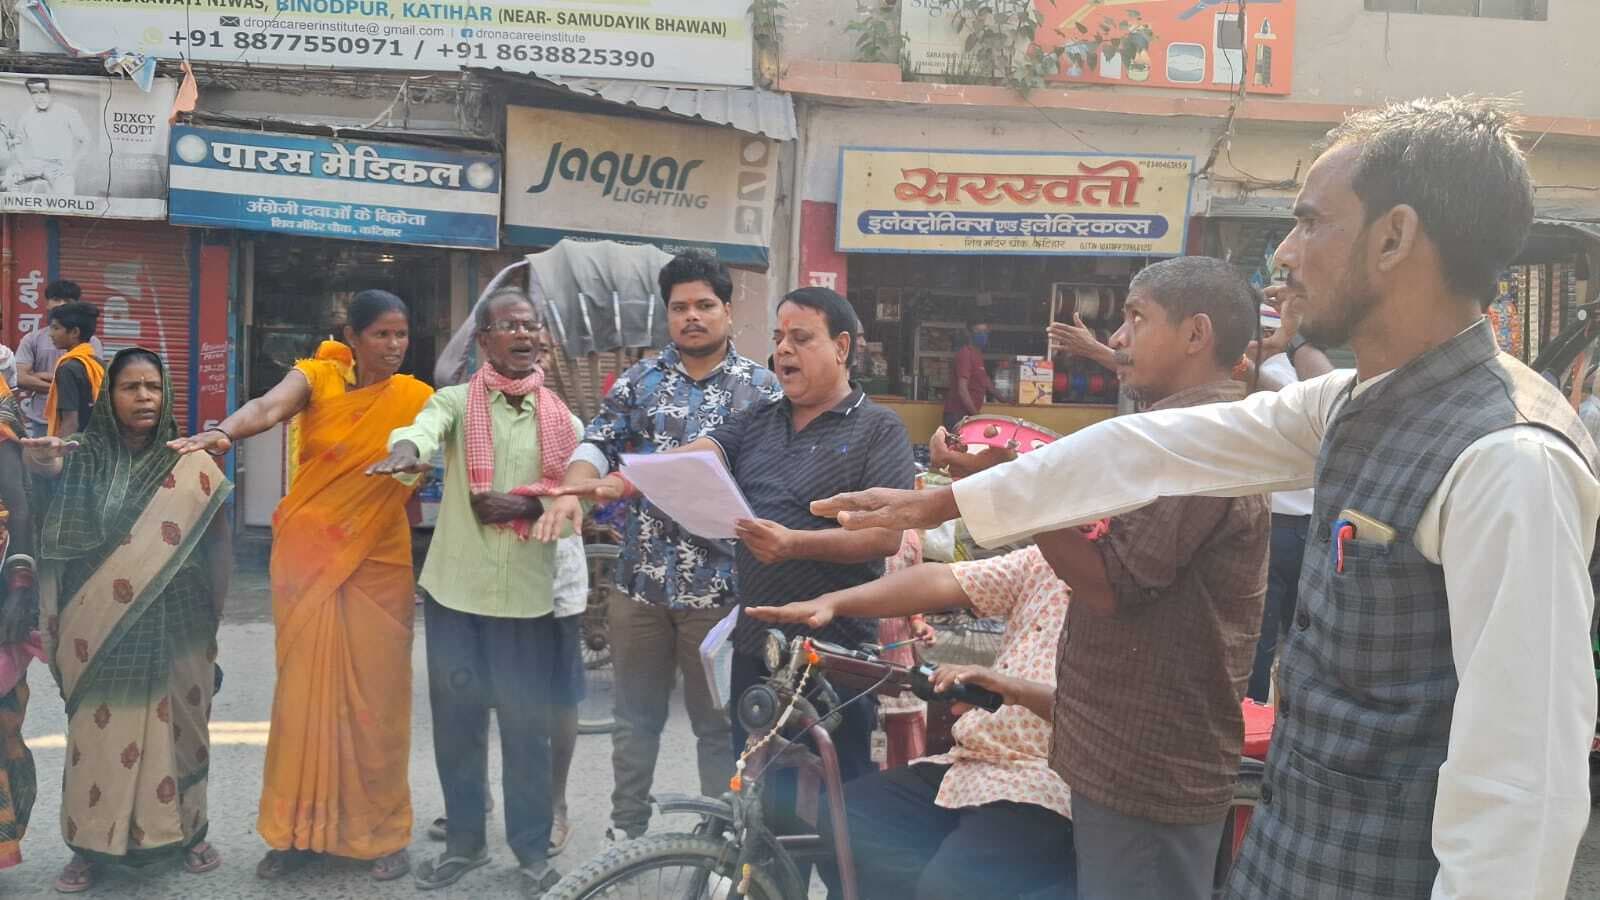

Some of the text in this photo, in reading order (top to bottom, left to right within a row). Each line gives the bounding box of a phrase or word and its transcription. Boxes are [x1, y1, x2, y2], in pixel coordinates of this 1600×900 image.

[276, 0, 394, 19] BINODPUR,
[403, 2, 493, 22] KATIHAR
[498, 8, 552, 24] (NEAR-
[556, 13, 651, 31] SAMUDAYIK
[655, 18, 728, 36] BHAWAN)
[383, 24, 445, 37] gmail.com
[169, 29, 224, 48] +91
[233, 31, 403, 56] 8877550971
[436, 41, 487, 60] +91
[496, 44, 655, 68] 8638825390
[113, 112, 156, 124] DIXCY
[112, 124, 156, 135] SCOTT
[211, 141, 464, 188] पारस मेडिकल
[894, 159, 1145, 208] सरस्वती
[4, 197, 95, 211] INNER WORLD
[612, 187, 711, 210] LIGHTING
[354, 207, 371, 221] के
[375, 208, 428, 226] विक्रेता
